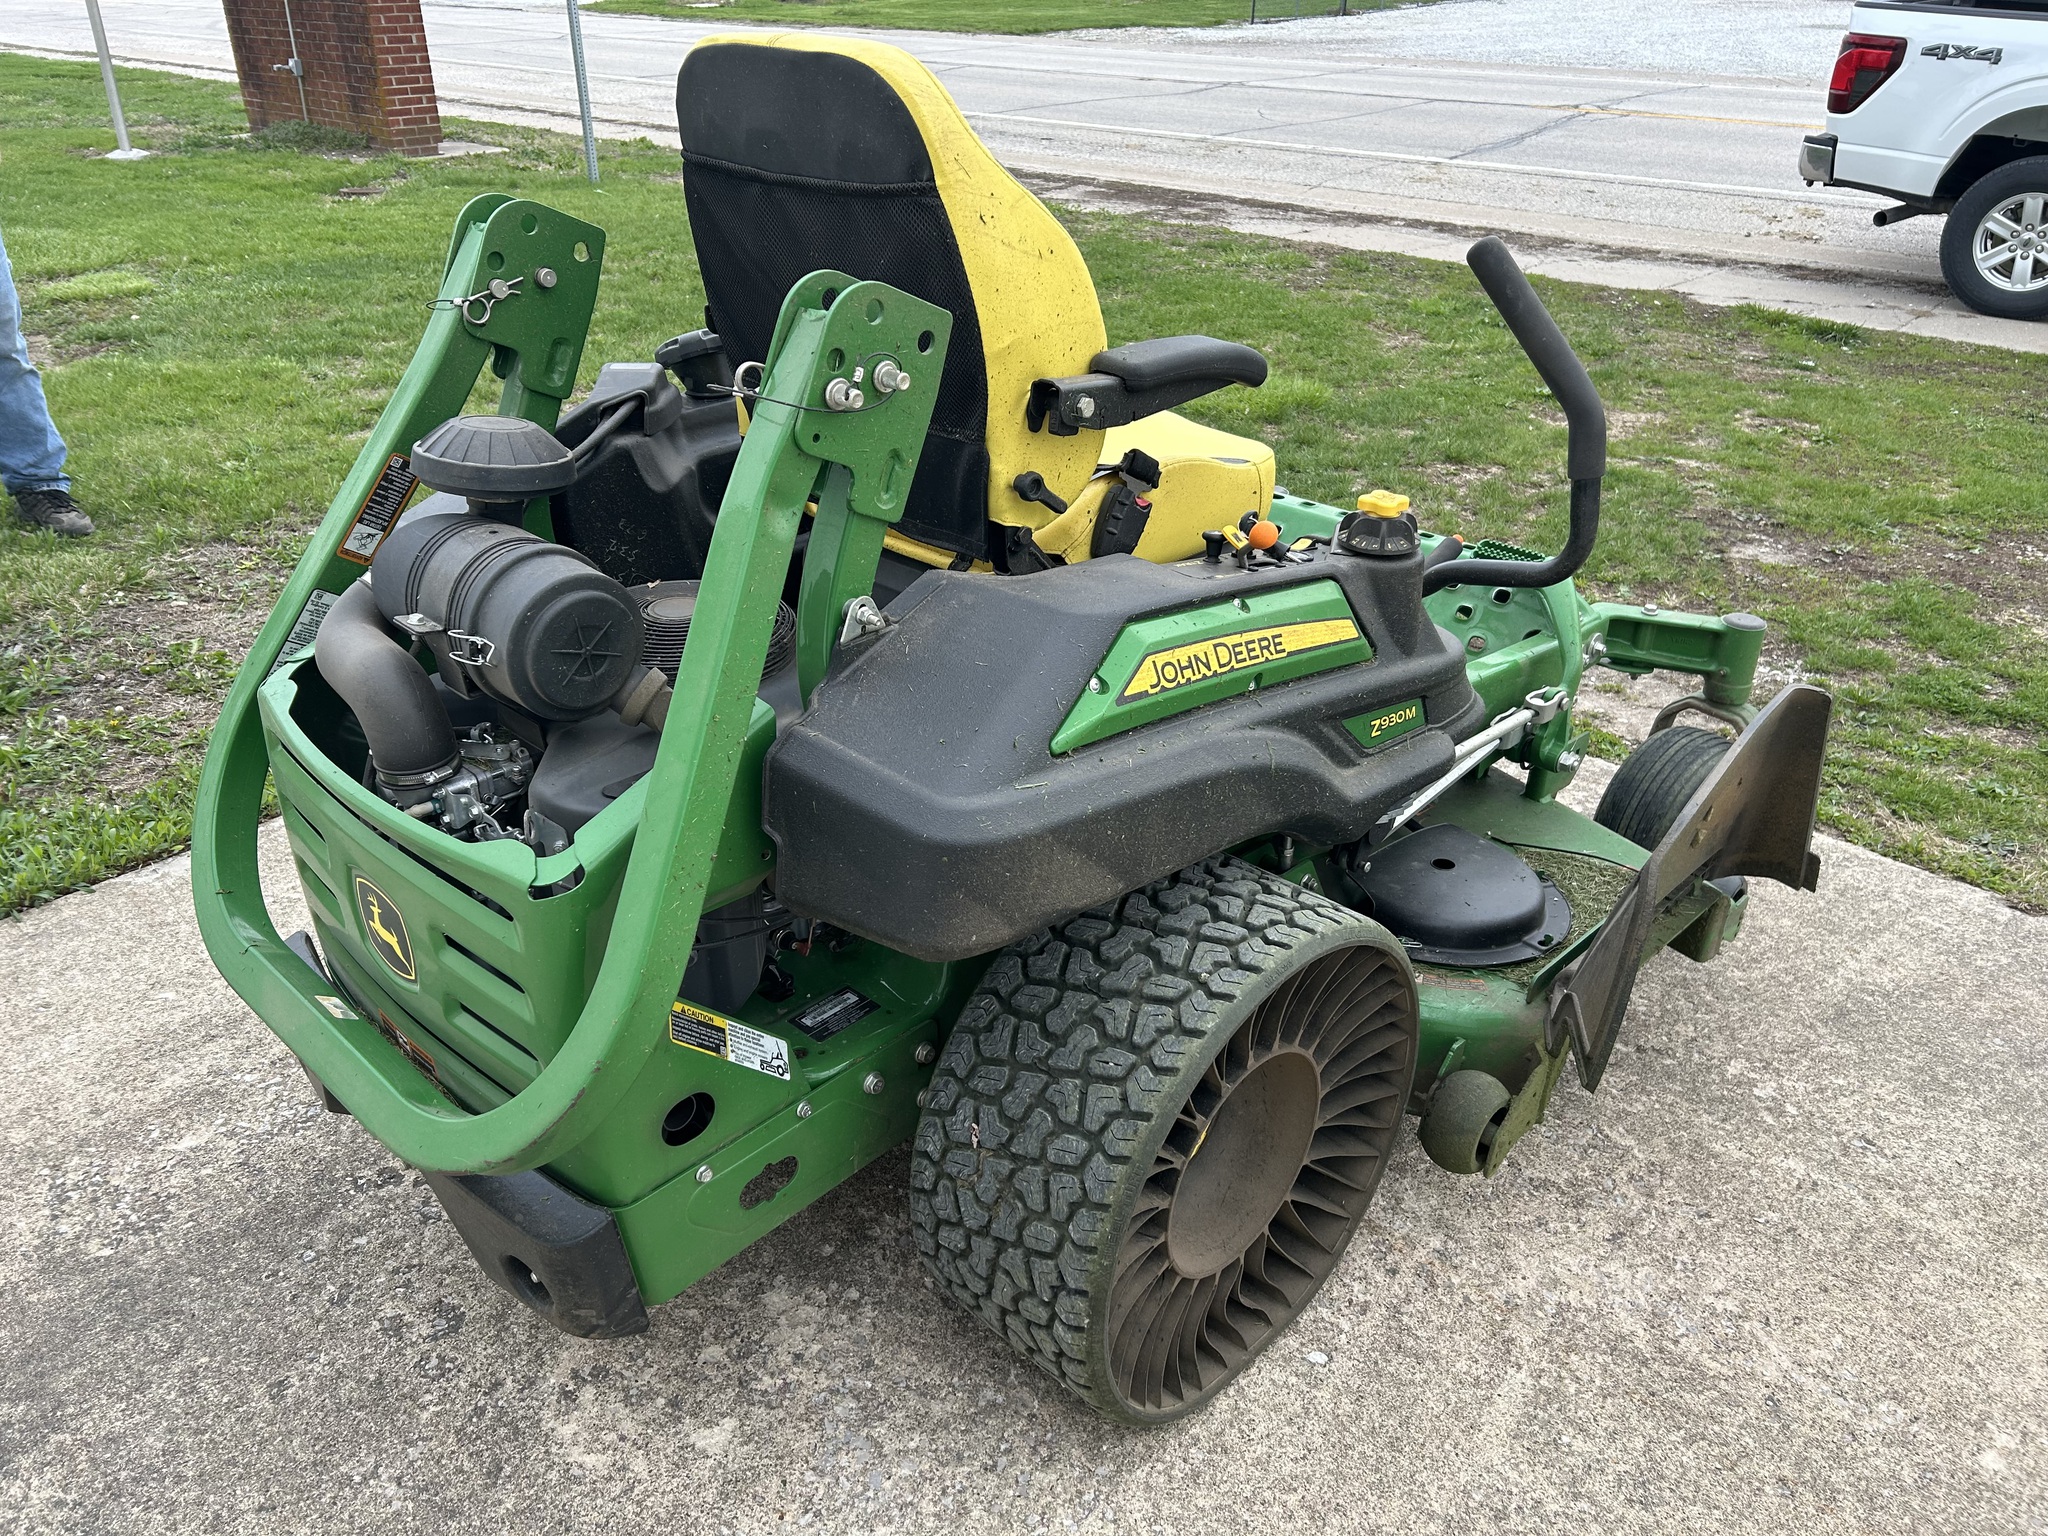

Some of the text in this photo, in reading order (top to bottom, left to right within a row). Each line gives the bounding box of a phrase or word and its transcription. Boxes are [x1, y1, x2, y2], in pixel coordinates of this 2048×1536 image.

[1148, 633, 1287, 690] JOHN DEERE
[1369, 705, 1417, 738] Z930M
[686, 1008, 714, 1024] CAUTION
